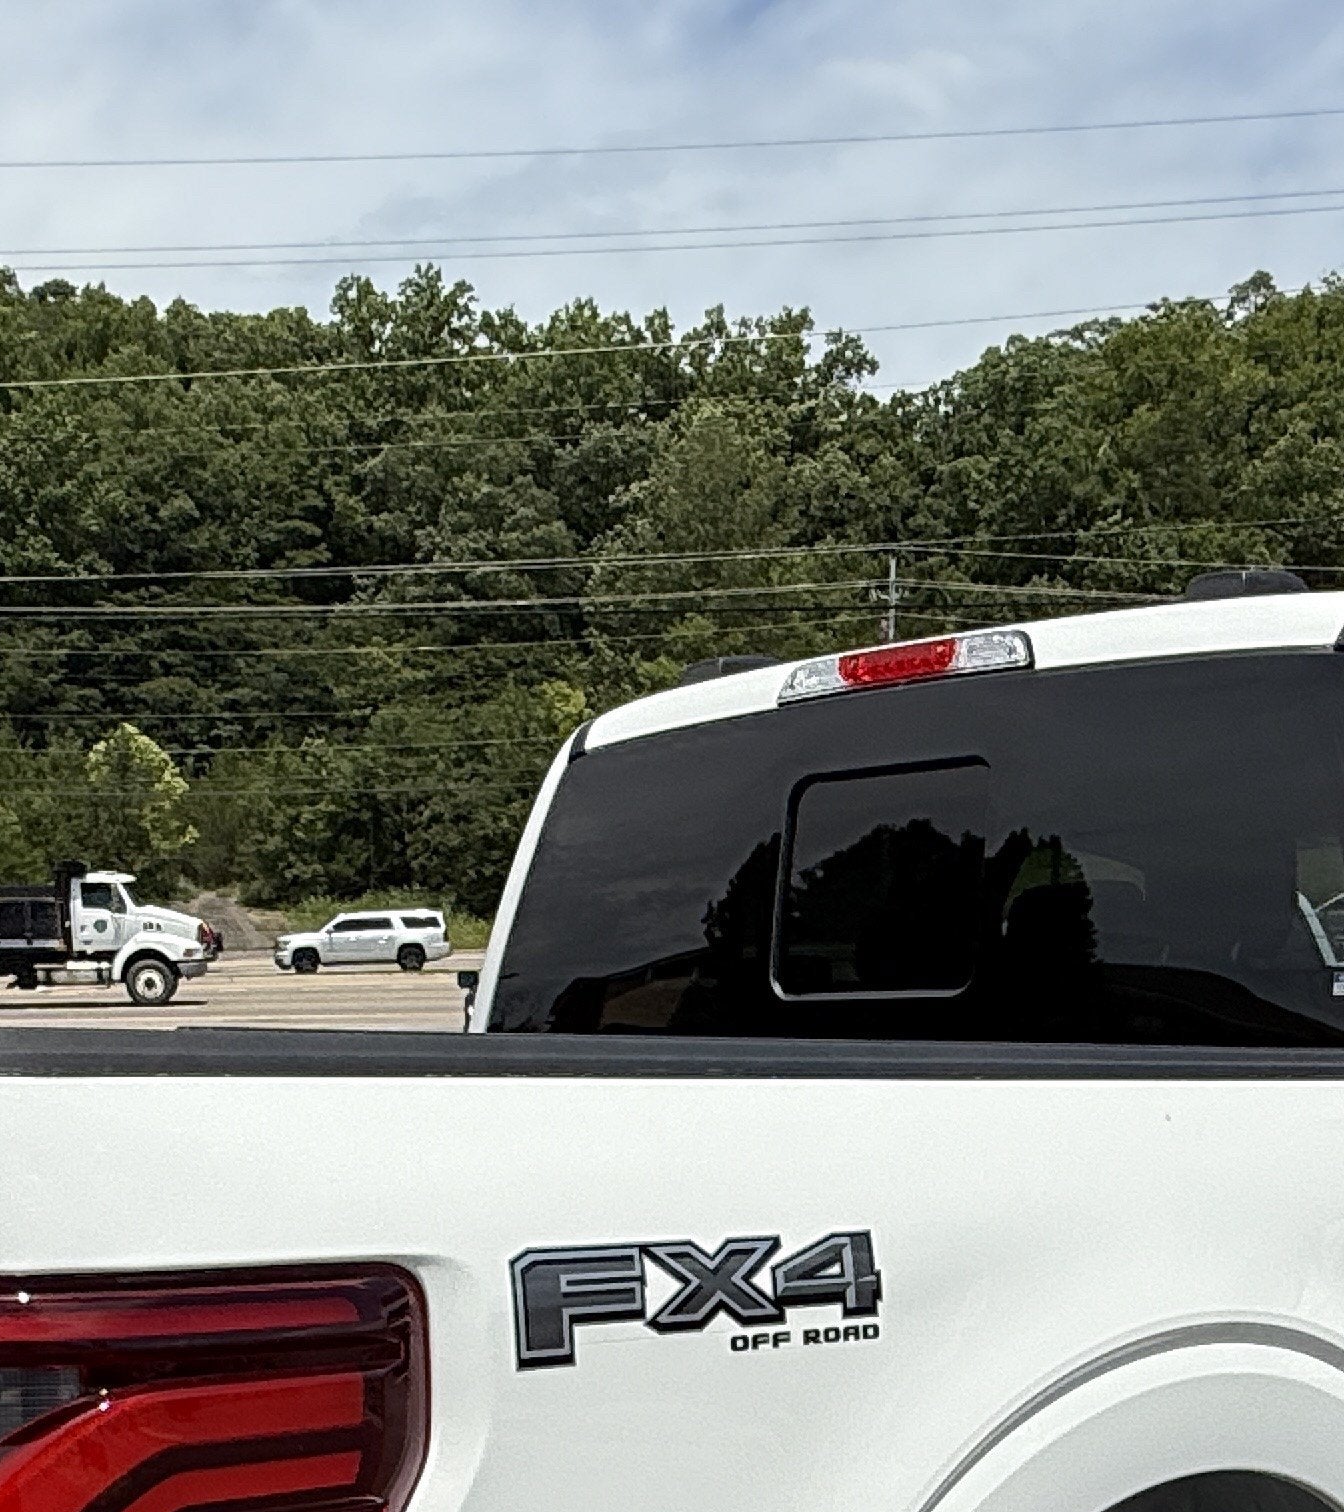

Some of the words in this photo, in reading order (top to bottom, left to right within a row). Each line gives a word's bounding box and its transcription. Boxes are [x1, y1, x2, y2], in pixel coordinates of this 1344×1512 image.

[509, 1229, 882, 1371] FX4
[730, 1330, 792, 1352] OFF
[802, 1323, 880, 1346] ROAD
